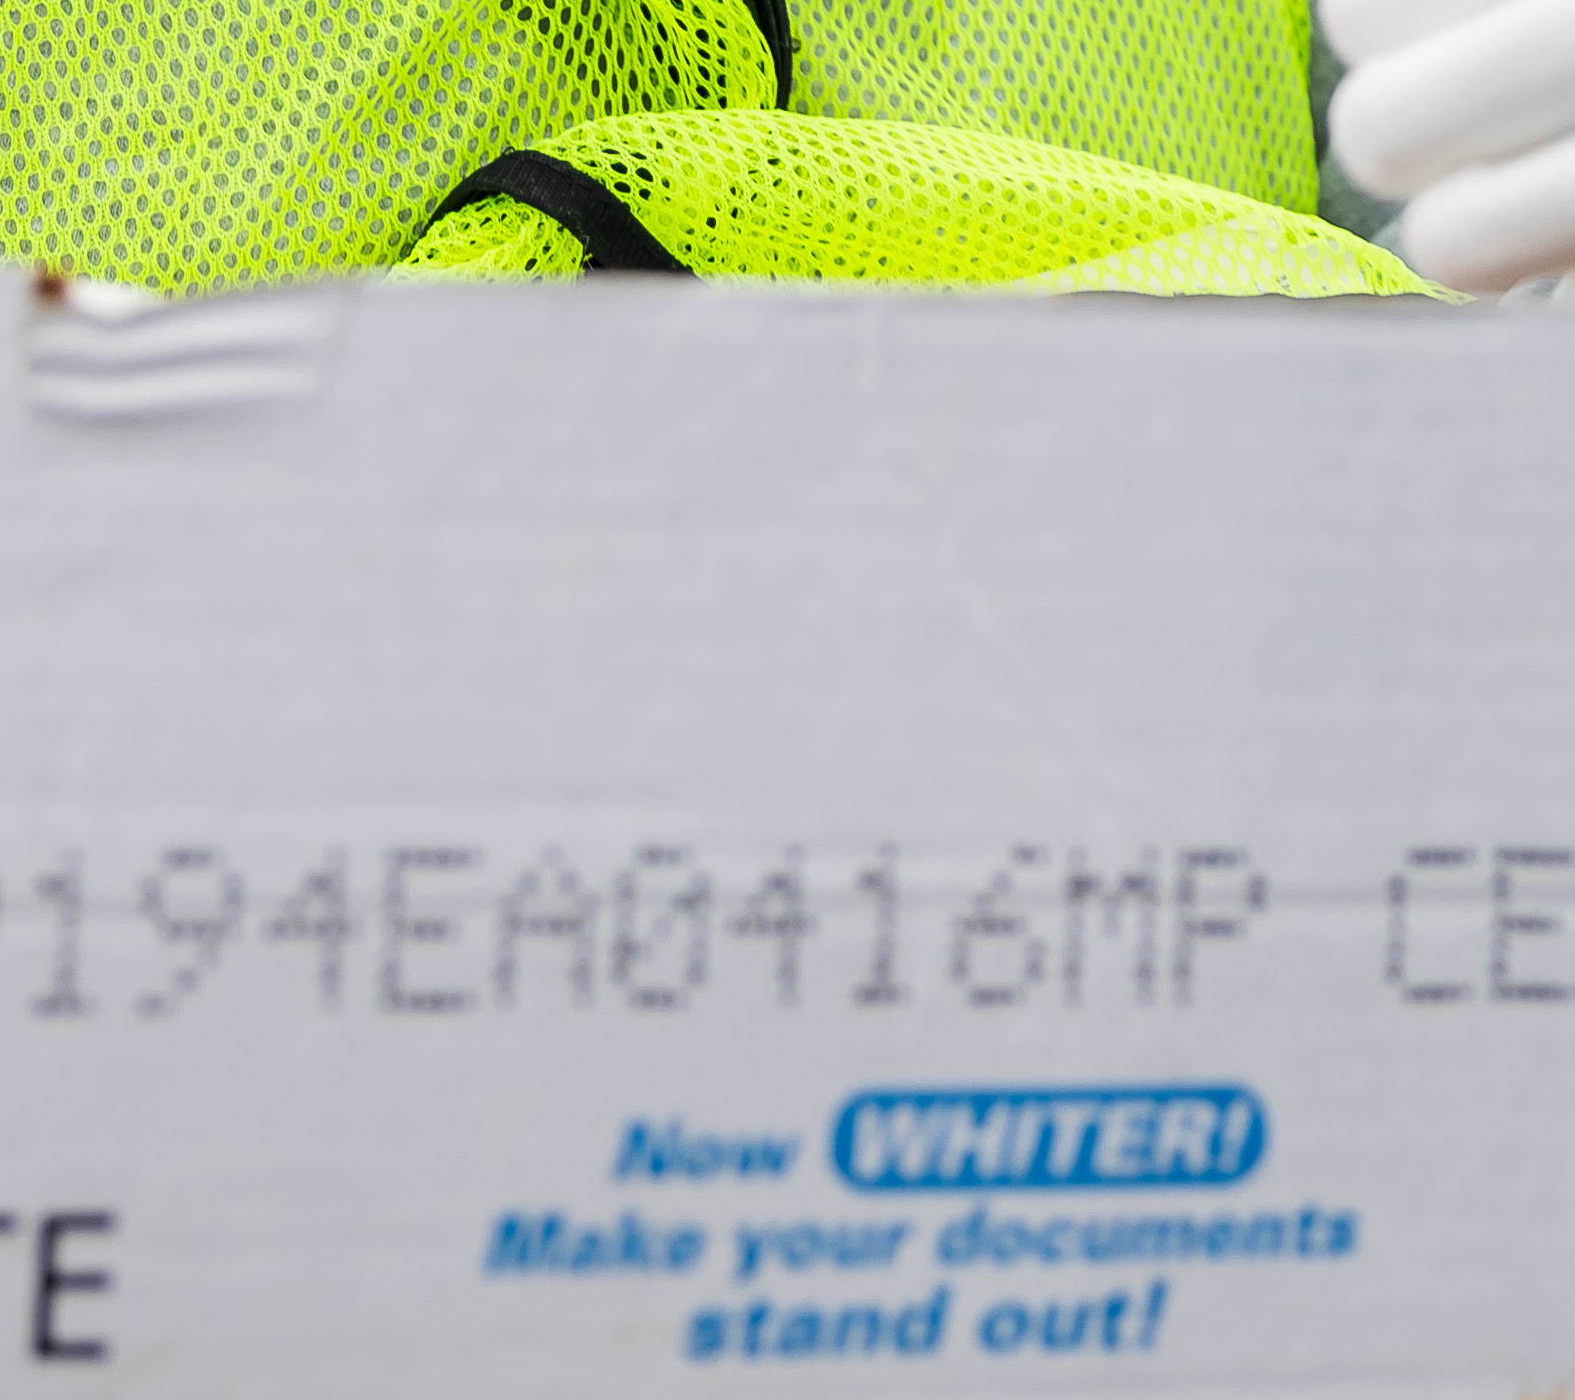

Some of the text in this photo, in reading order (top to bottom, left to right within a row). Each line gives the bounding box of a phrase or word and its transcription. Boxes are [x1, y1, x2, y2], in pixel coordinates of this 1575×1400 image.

[612, 1094, 1257, 1187] Now WHITER!
[482, 1202, 1362, 1284] Make your documents
[682, 1277, 1169, 1364] stand out!
